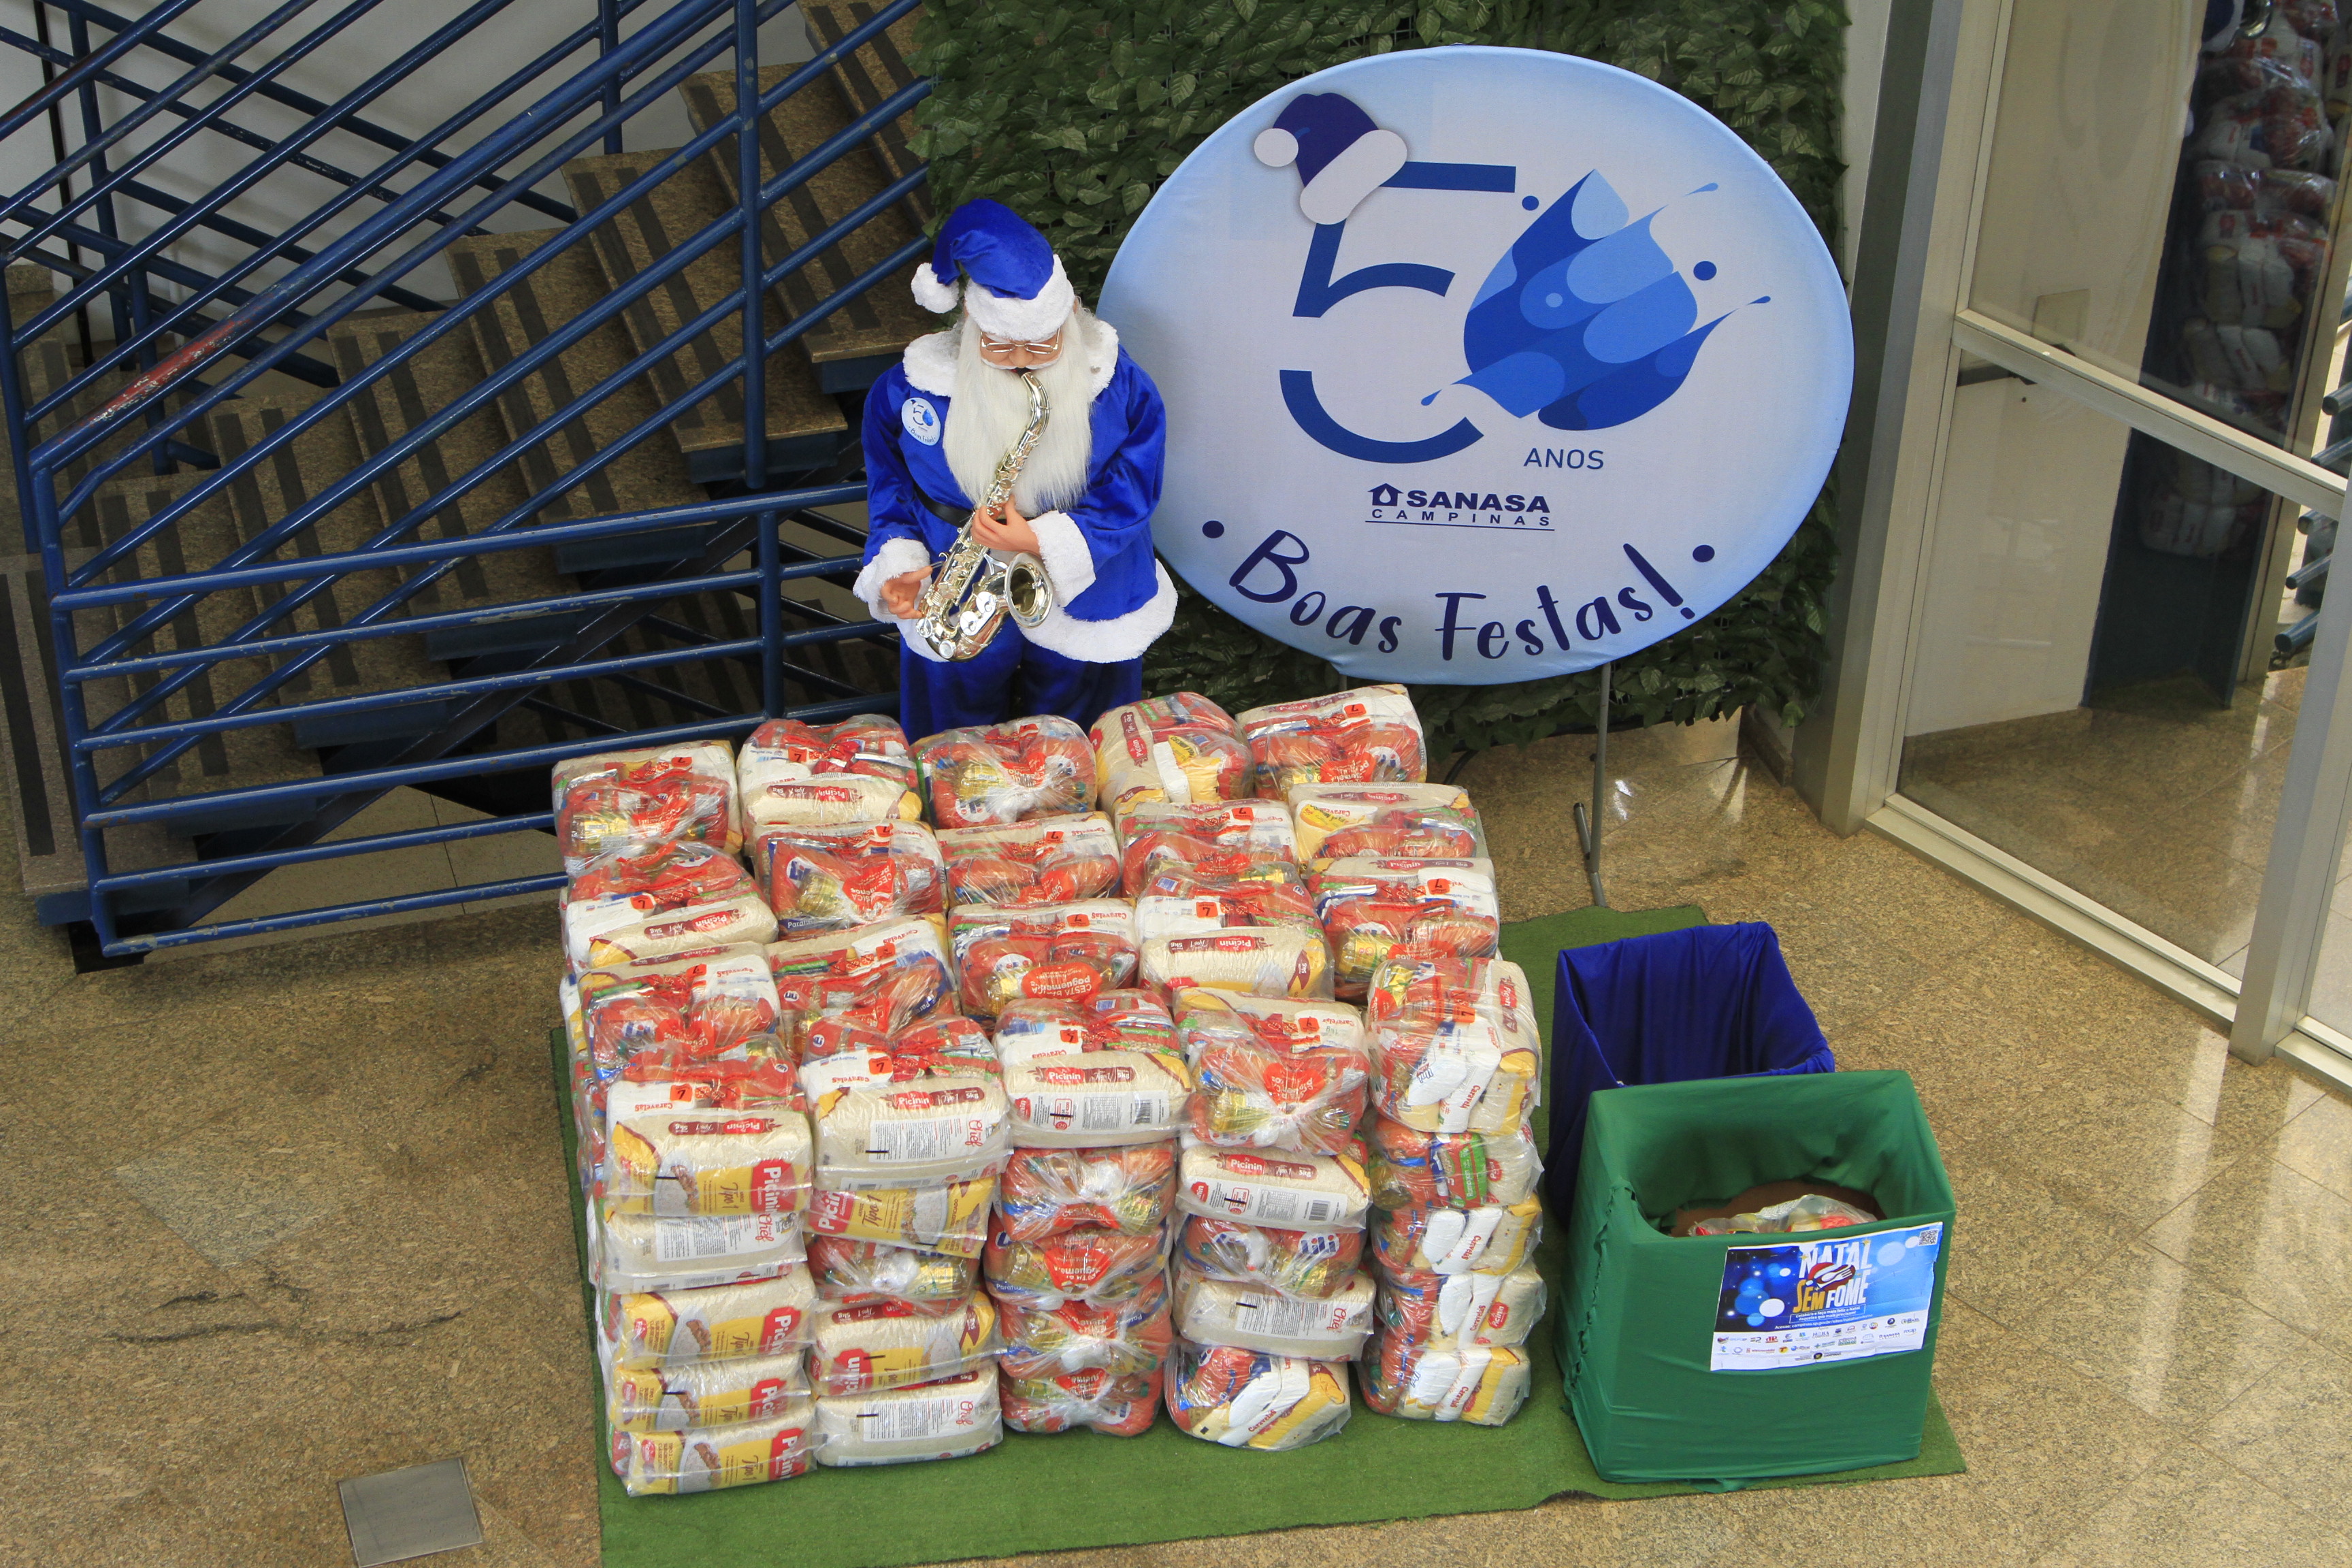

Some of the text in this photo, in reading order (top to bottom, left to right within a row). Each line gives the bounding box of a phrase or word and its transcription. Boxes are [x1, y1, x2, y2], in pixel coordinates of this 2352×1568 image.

[1523, 447, 1605, 471] ANOS
[1406, 489, 1550, 514] SANASA
[1371, 507, 1552, 527] CAMPINAS
[1229, 529, 1695, 661] Boas Festas!
[794, 753, 802, 762] 7
[819, 787, 847, 799] Picinin
[1203, 906, 1211, 916] 7
[696, 915, 728, 928] Picinin
[1218, 938, 1252, 950] Picinin
[1064, 983, 1092, 996] CESTA
[876, 1062, 885, 1073] 7
[832, 1076, 870, 1084] Caravelas
[1048, 1072, 1081, 1081] Picinin
[676, 1089, 686, 1100] 7
[898, 1096, 930, 1105] Picinin
[634, 1102, 673, 1112] Caravelas
[726, 1122, 761, 1131] Picinin
[1230, 1158, 1263, 1171] Picinin
[718, 1181, 739, 1205] Tipo
[862, 1194, 883, 1227] Tipo 1
[1799, 1240, 1873, 1278] NATAL
[1793, 1269, 1872, 1313] SEM FOME
[1247, 1409, 1277, 1433] Caravelas
[741, 1455, 759, 1475] Tipo
